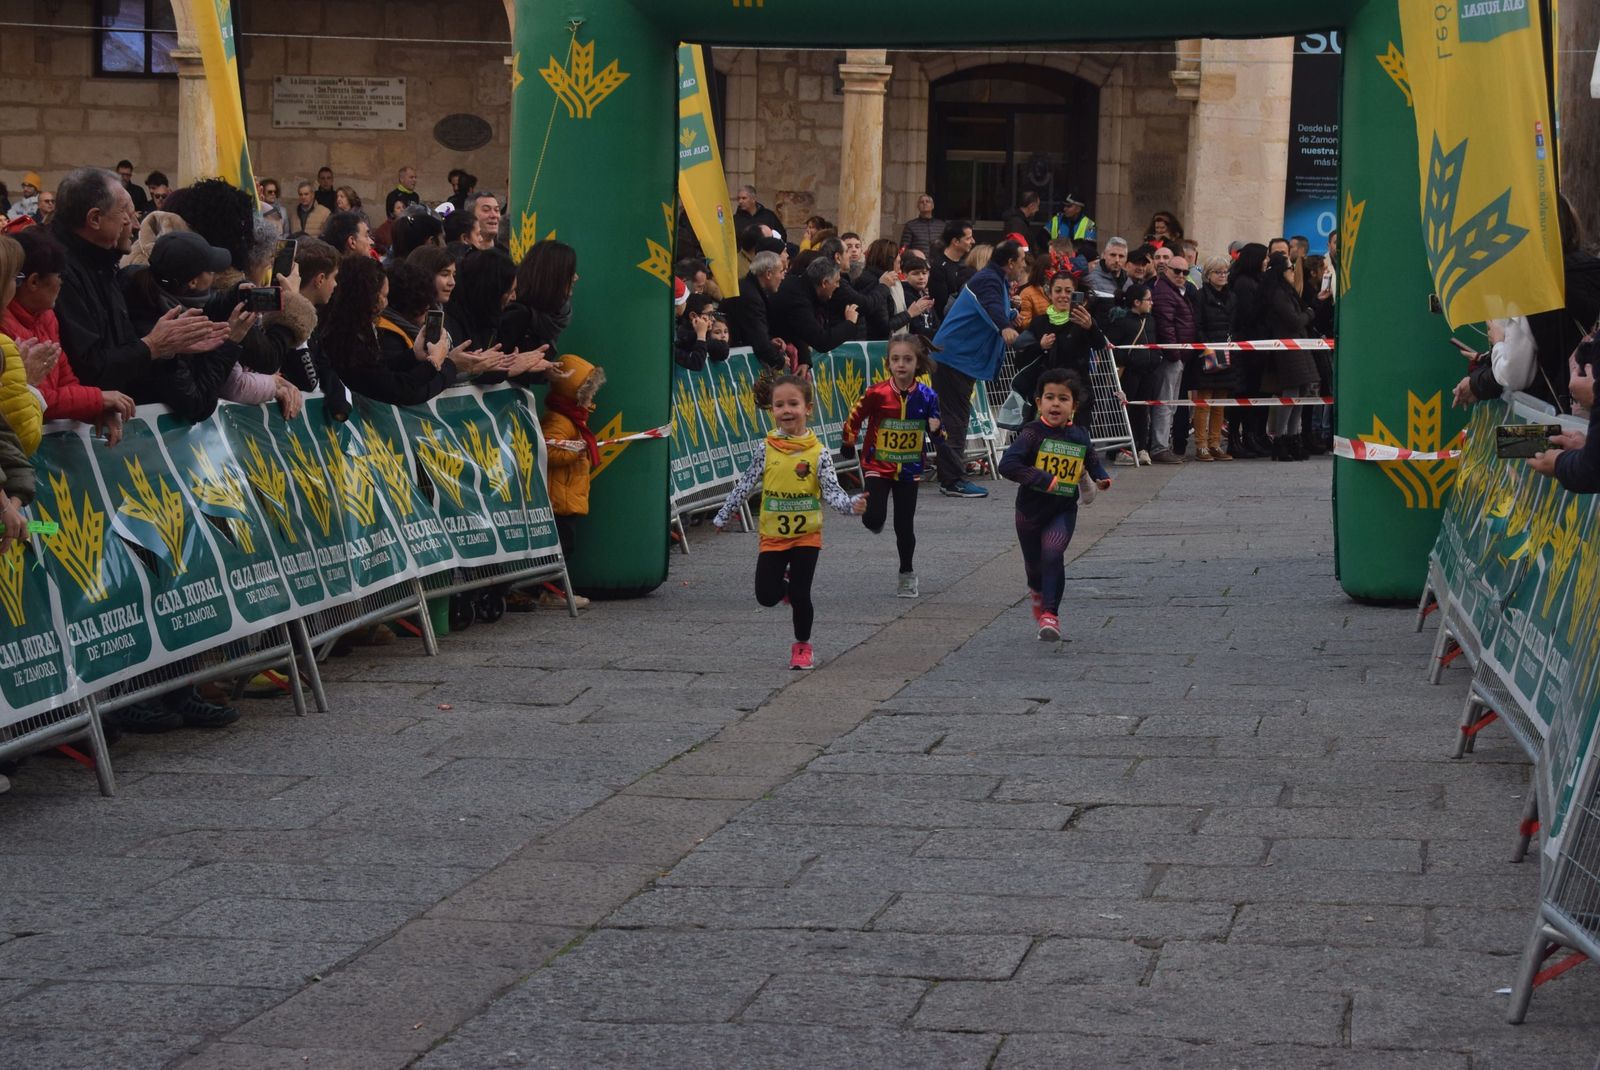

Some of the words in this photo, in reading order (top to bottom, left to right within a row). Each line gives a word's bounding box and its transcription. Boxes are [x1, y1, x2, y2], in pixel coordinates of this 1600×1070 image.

[1297, 123, 1322, 133] Desde
[1324, 124, 1331, 132] la
[1299, 135, 1309, 144] de
[1301, 147, 1334, 155] nuestra
[1313, 158, 1331, 166] más
[882, 431, 917, 450] 1323
[1041, 455, 1078, 480] 1334
[444, 516, 468, 534] CAJA
[778, 515, 807, 535] 32
[410, 537, 442, 555] AMORA
[456, 535, 466, 546] DE
[466, 532, 489, 545] ZAMORA
[230, 566, 256, 591] CAJA
[252, 559, 280, 584] RURAL
[281, 554, 300, 575] CAJA
[154, 589, 185, 616] CAJA
[182, 576, 223, 607] RURAL
[245, 591, 258, 605] DE
[257, 583, 280, 602] ZAMORA
[67, 616, 102, 647] CAJA
[99, 602, 144, 636] RURAL
[171, 614, 185, 631] DE
[184, 604, 218, 627] ZAMORA
[22, 630, 60, 661] RURAL
[86, 645, 101, 662] DE
[101, 632, 137, 656] ZAMORA
[13, 667, 25, 687] DE
[24, 660, 58, 684] ZAMORA
